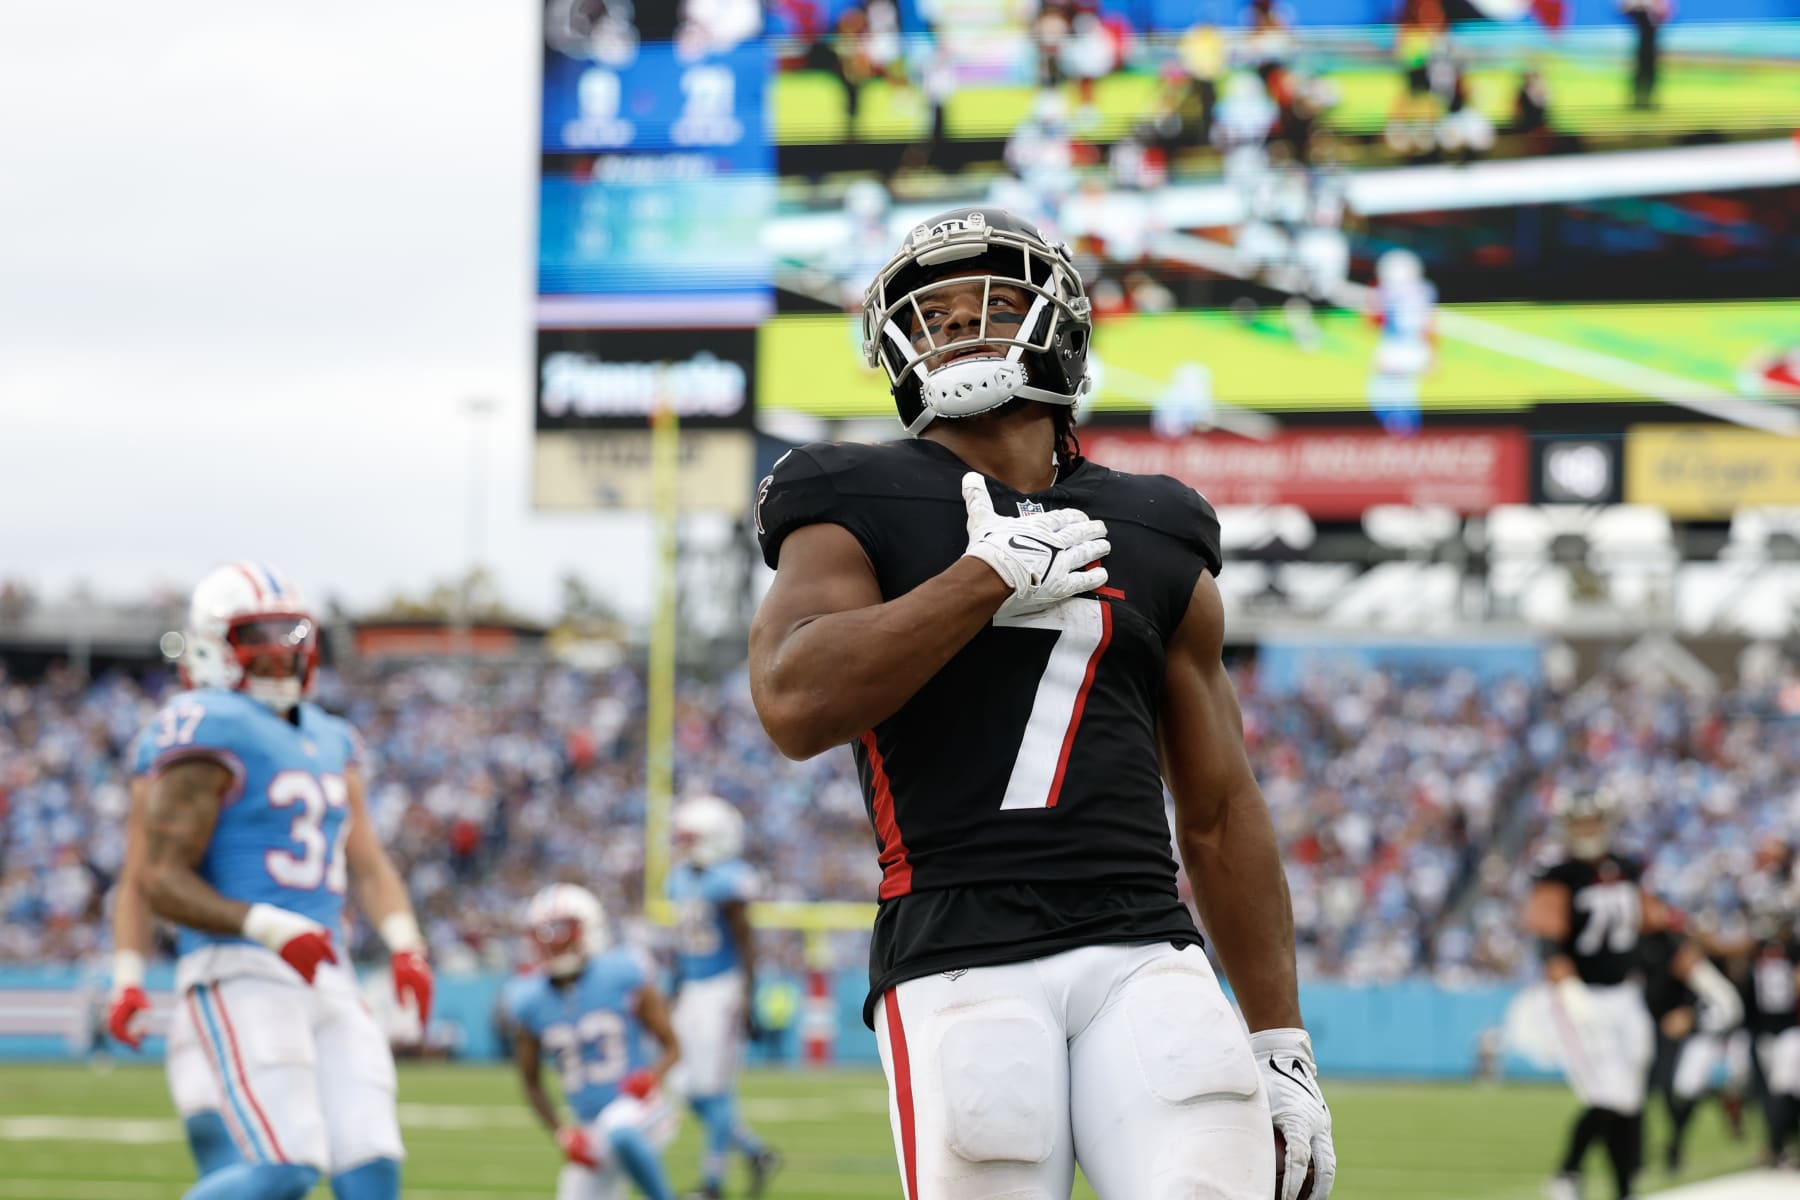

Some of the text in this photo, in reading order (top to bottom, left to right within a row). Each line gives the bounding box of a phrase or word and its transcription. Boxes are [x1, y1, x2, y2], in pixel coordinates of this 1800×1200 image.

[932, 221, 968, 236] ATL
[992, 588, 1114, 810] 7
[153, 703, 206, 748] 37
